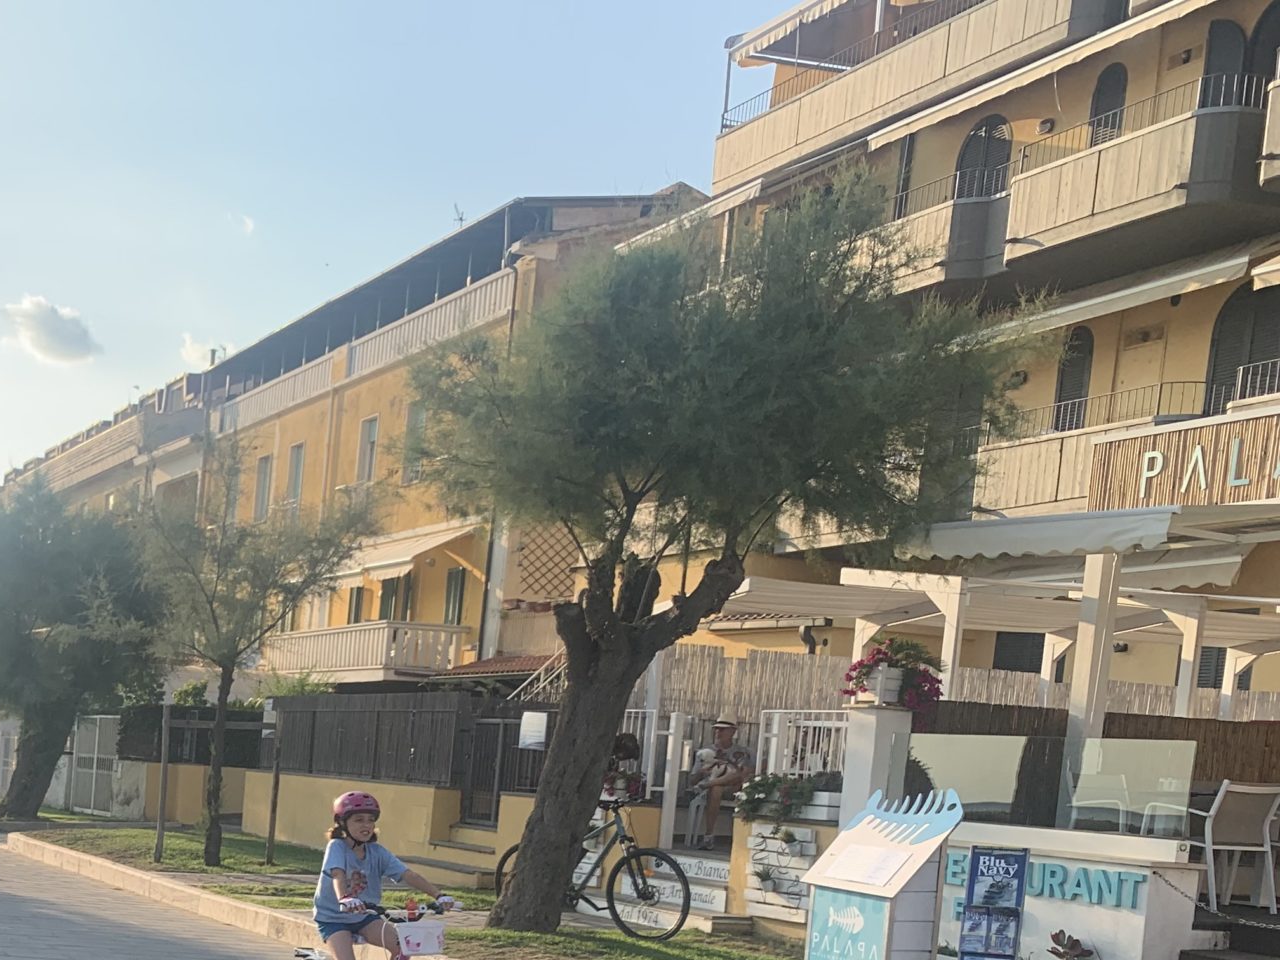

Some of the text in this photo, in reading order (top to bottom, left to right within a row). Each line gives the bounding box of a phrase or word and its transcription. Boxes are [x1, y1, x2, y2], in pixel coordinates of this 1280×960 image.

[1140, 438, 1280, 498] PAL
[695, 860, 730, 879] Bianco
[977, 865, 1019, 877] Navy
[978, 855, 1012, 868] Blu
[636, 907, 659, 926] 1974
